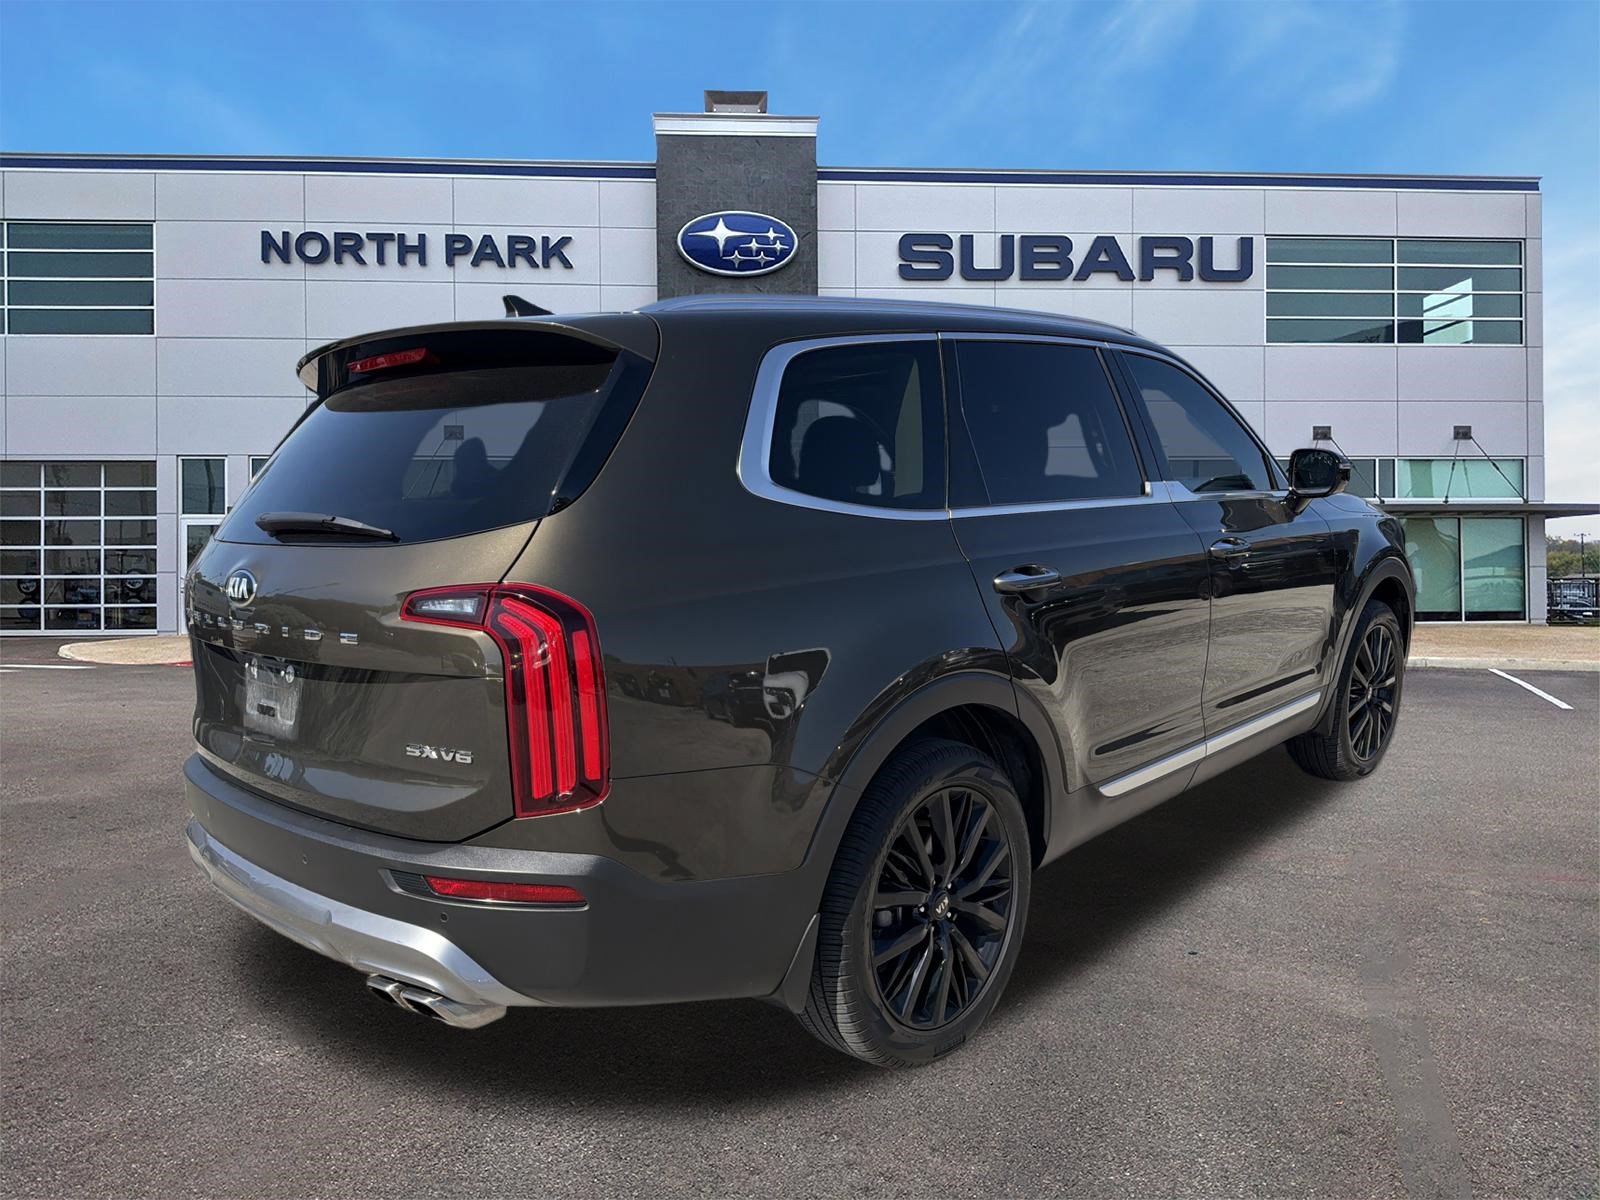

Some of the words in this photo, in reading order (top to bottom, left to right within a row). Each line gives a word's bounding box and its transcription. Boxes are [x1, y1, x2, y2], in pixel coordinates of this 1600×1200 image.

[260, 230, 428, 266] NORTH
[444, 233, 574, 269] PARK
[898, 232, 1254, 282] SUBARU
[227, 576, 250, 599] KIA
